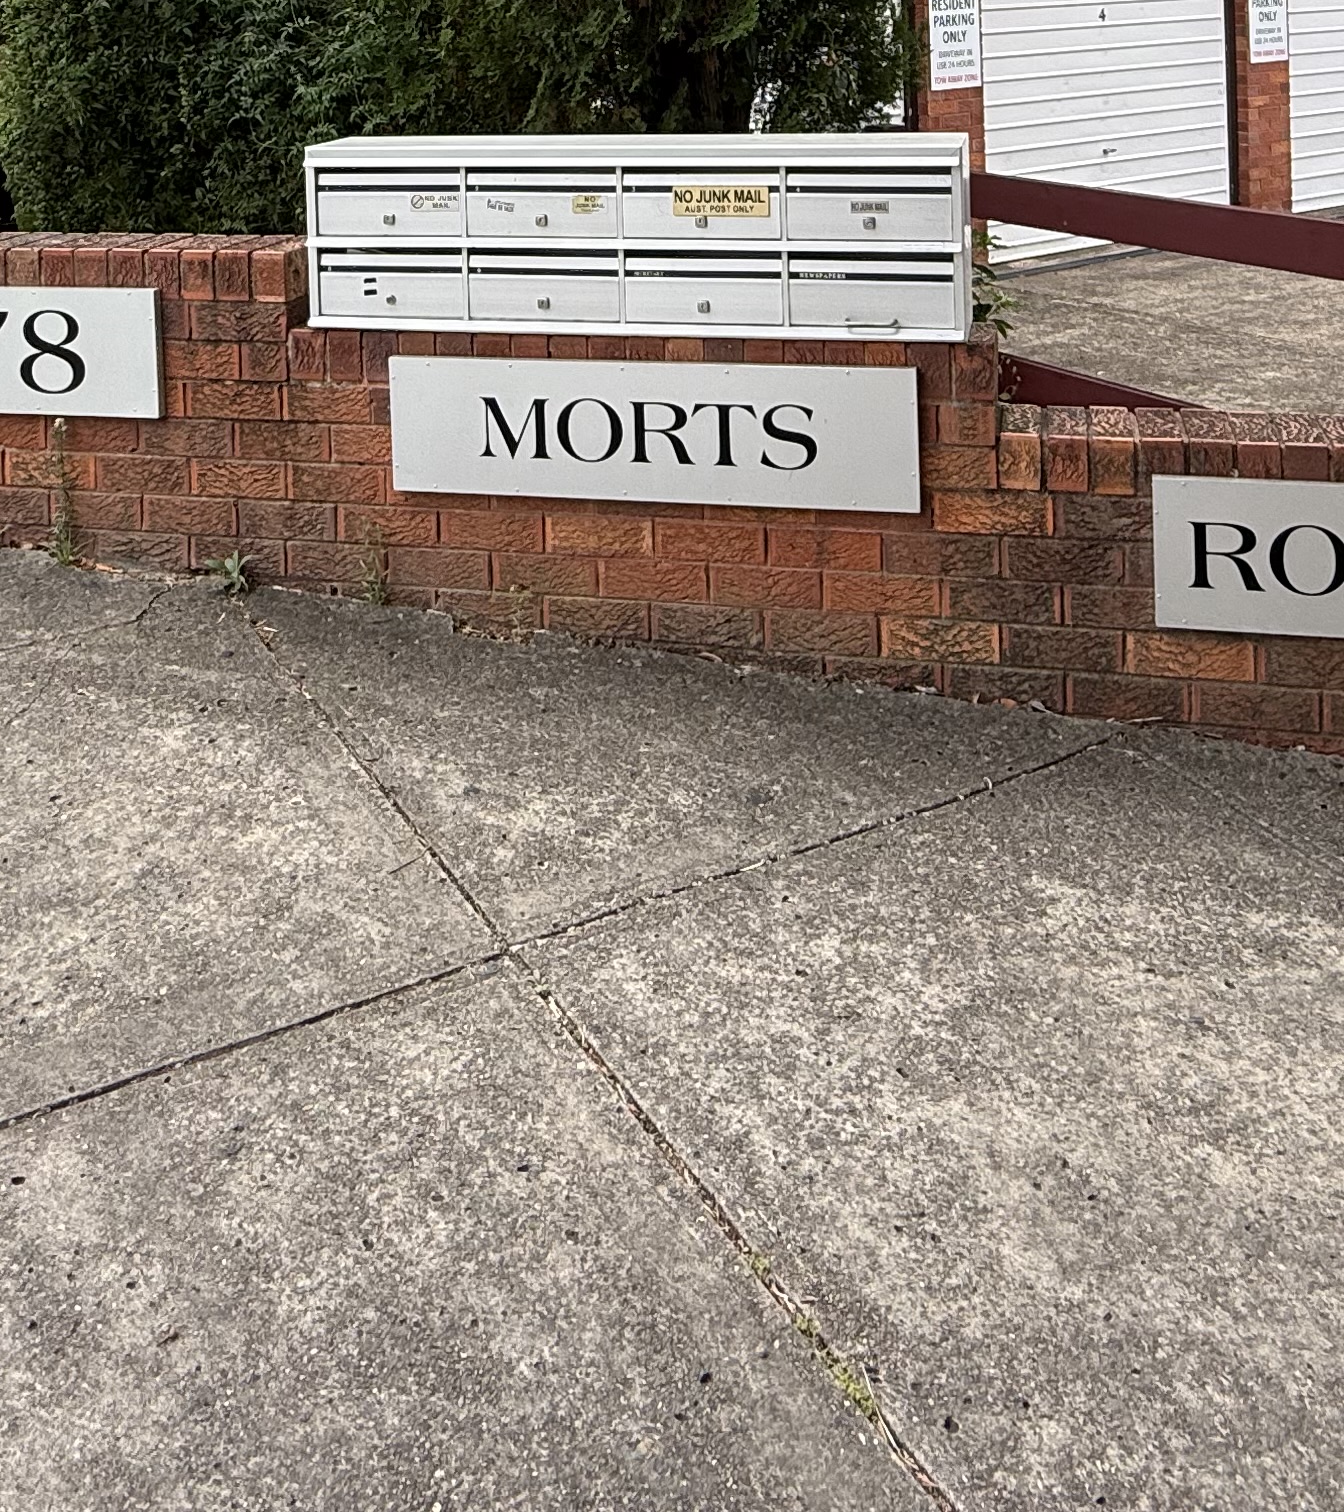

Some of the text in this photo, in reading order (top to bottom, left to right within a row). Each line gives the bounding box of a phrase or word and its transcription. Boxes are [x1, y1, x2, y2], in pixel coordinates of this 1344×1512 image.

[933, 12, 975, 28] PARKING
[1098, 7, 1107, 22] 4
[1258, 9, 1278, 23] ONLY
[942, 29, 968, 44] ONLY
[584, 195, 596, 203] NO
[673, 189, 766, 204] NO JUNK MAIL
[684, 204, 755, 214] AUST. POST ONLY
[480, 397, 818, 471] MORTS
